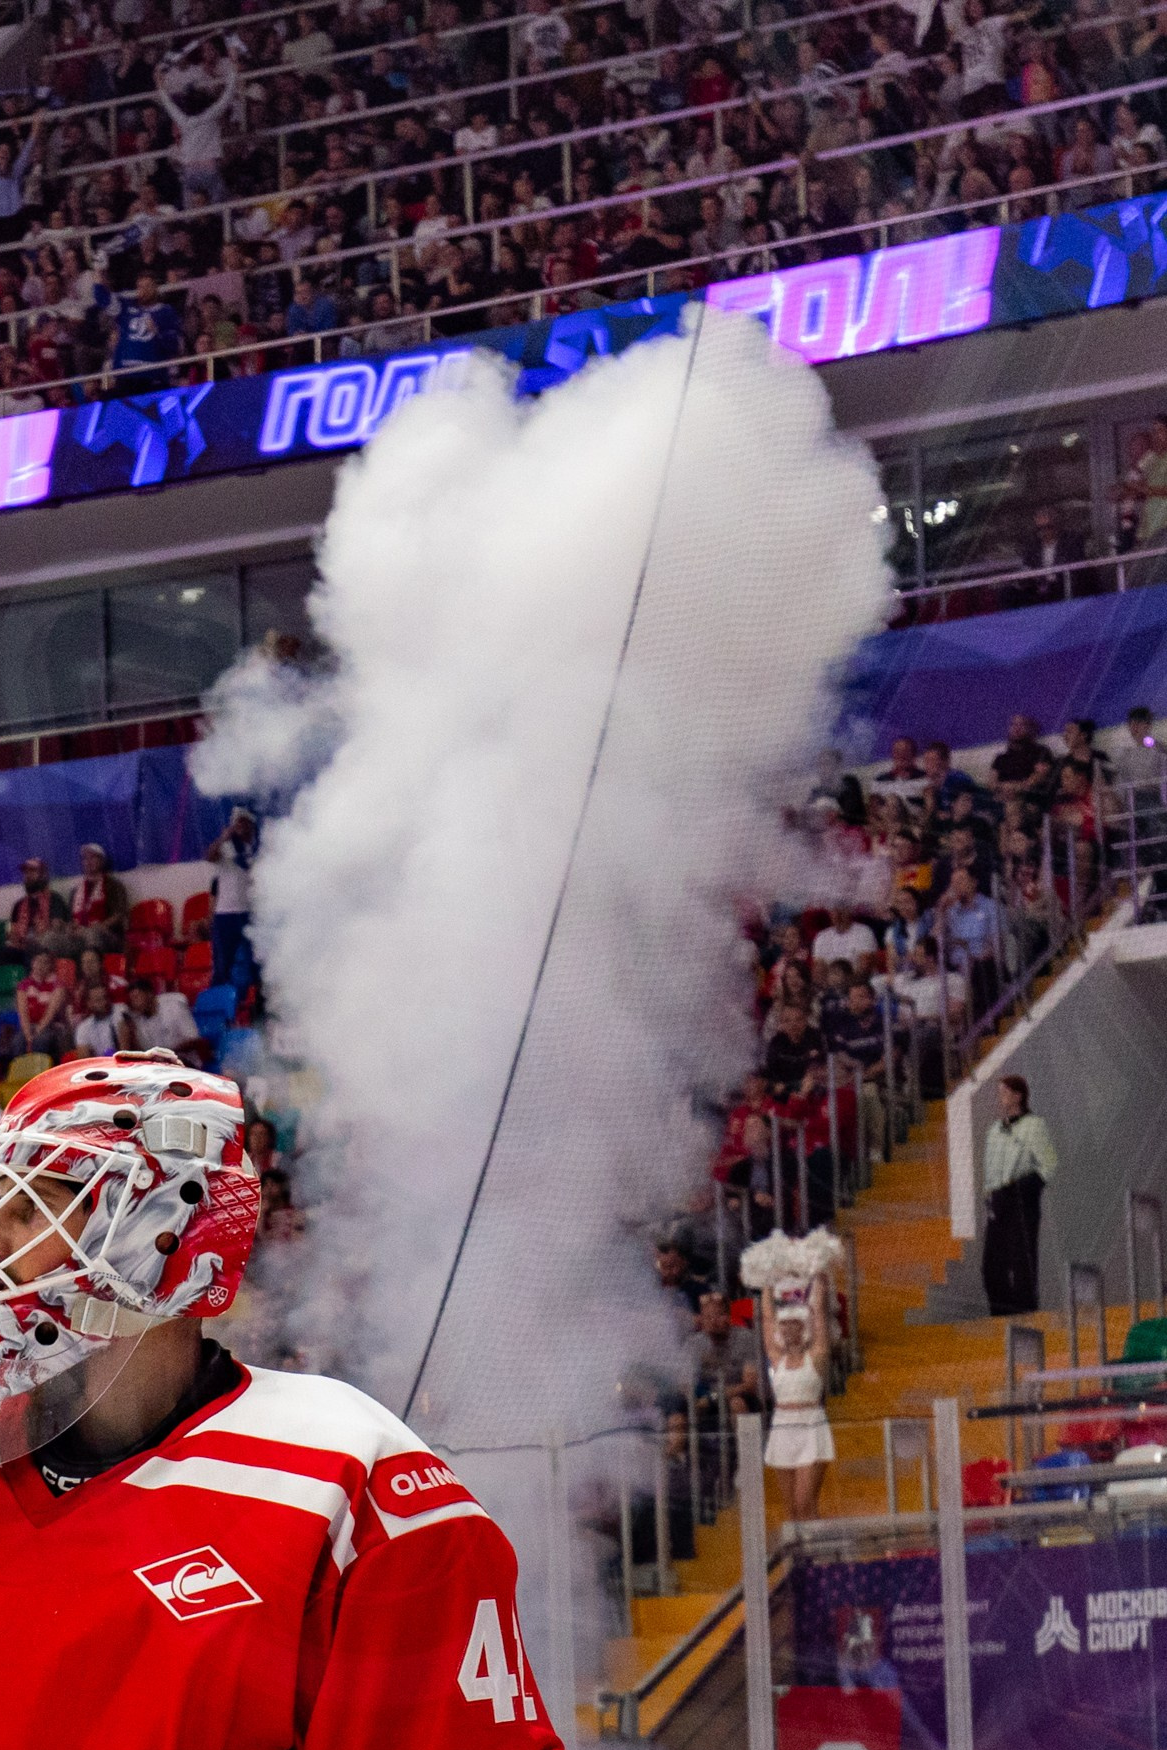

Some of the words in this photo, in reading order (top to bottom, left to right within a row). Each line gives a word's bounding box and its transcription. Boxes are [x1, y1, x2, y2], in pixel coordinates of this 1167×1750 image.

[41, 1464, 93, 1492] CC
[1087, 1620, 1152, 1653] СПОРТ
[457, 1599, 538, 1724] 4
